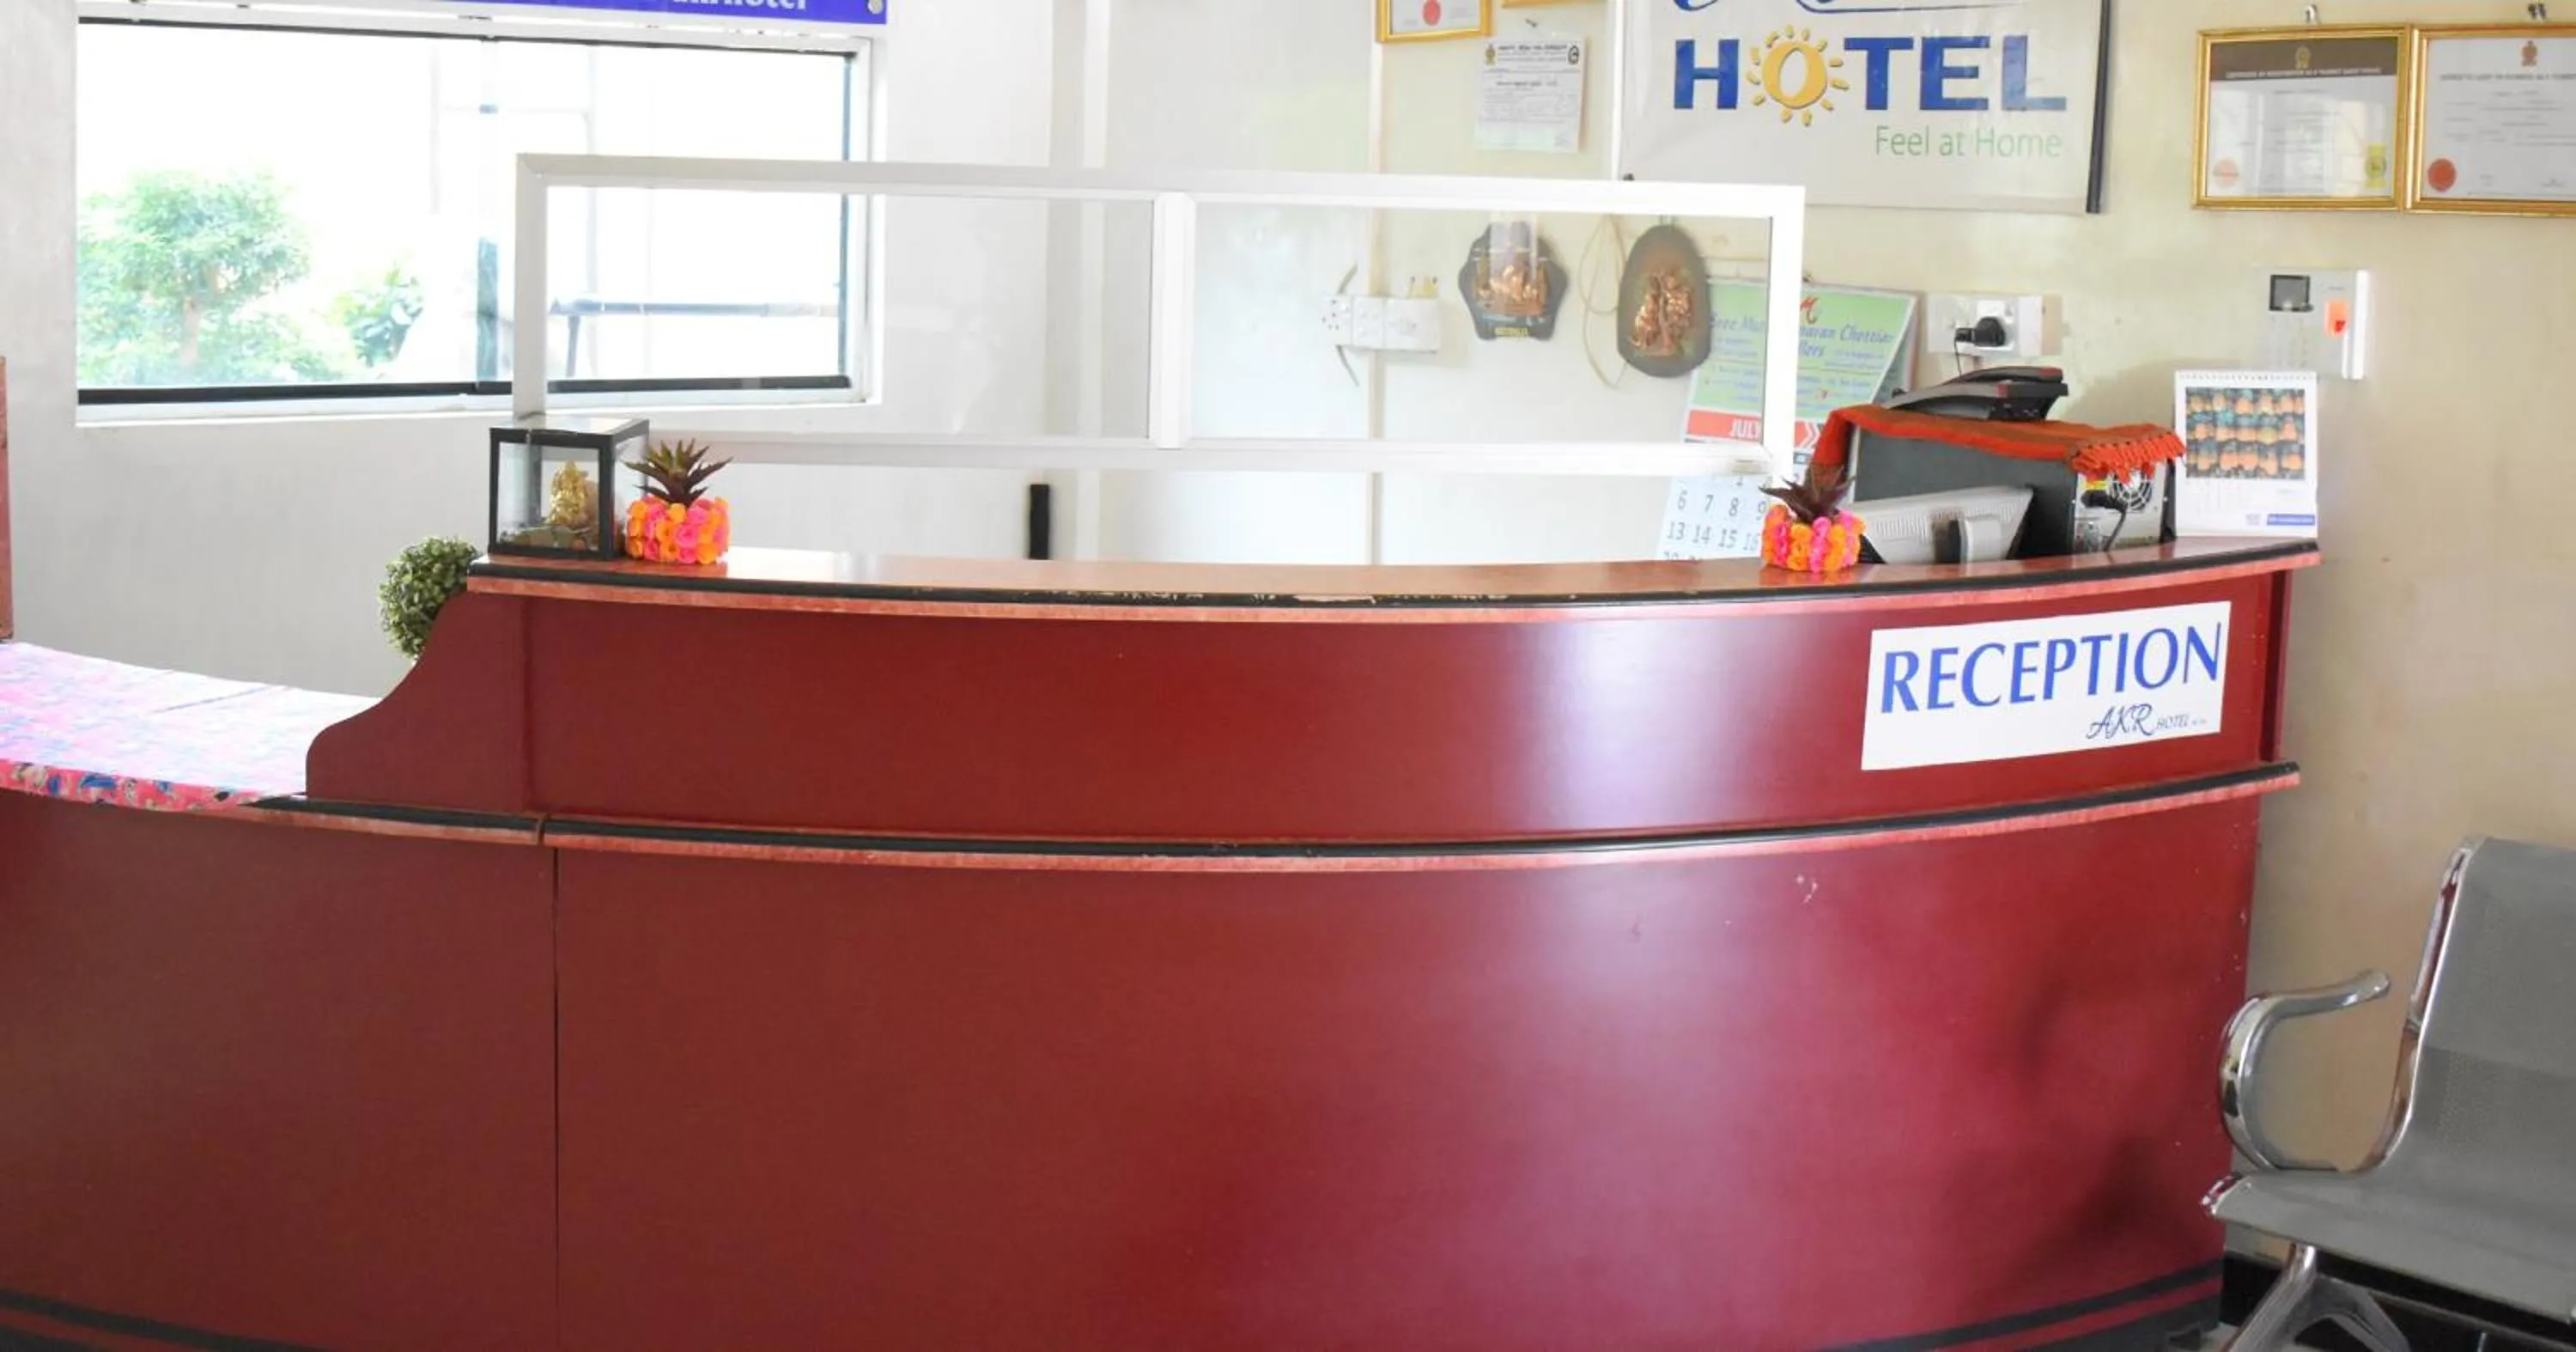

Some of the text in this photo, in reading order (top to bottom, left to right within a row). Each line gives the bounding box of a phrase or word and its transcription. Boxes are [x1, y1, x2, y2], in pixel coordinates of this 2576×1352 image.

[1674, 29, 2068, 117] HOTEL
[1875, 125, 2063, 158] Feel at Home
[1677, 489, 1688, 510] 6
[1704, 494, 1715, 513] 7
[1728, 496, 1740, 517] 8
[1666, 521, 1686, 541] 13
[1692, 523, 1712, 545] 14
[1717, 527, 1738, 549] 15
[1880, 621, 2222, 714] RECEPTION
[2086, 703, 2155, 740] AKR
